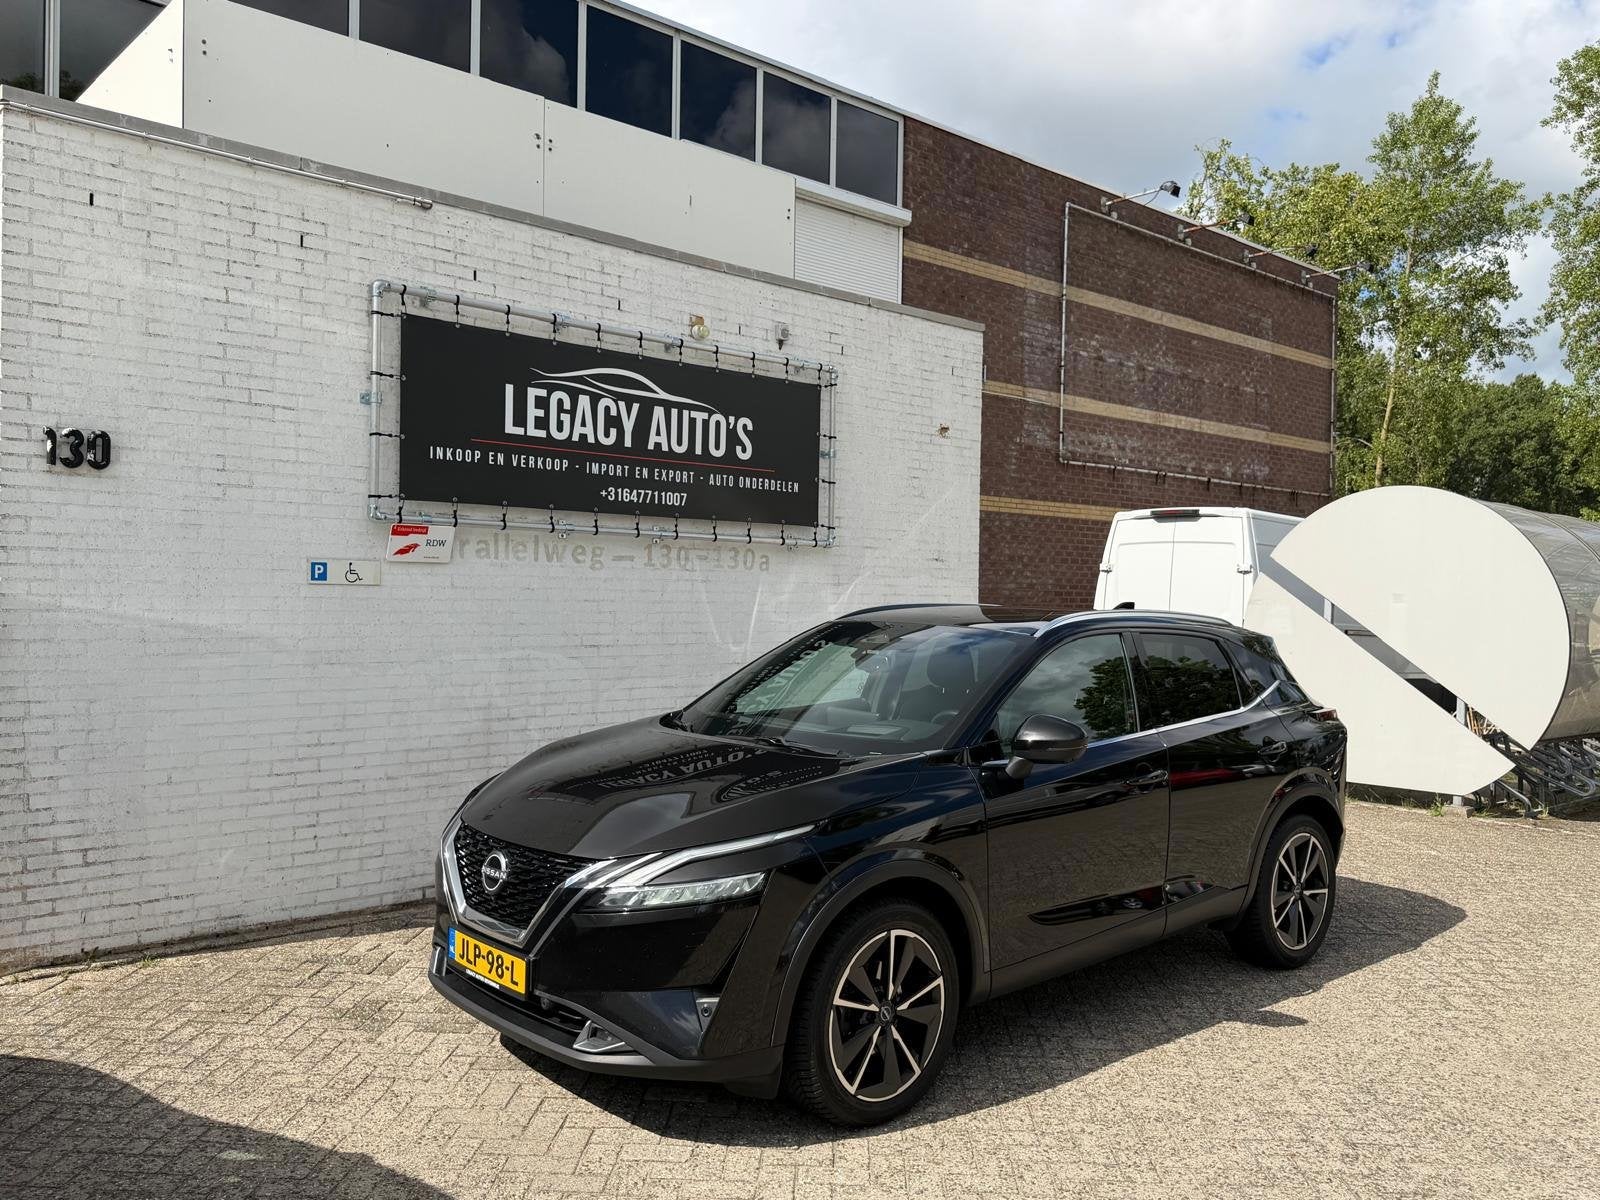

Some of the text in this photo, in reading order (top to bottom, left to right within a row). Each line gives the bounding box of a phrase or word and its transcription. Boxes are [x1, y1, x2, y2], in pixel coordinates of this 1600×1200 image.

[504, 383, 754, 461] LEGACY AUTO'S
[42, 425, 111, 470] 130
[429, 445, 481, 463] INKOOP
[488, 452, 504, 465] EN
[511, 454, 569, 471] VERKOOP
[586, 461, 630, 478] IMPORT
[635, 467, 648, 479] EN
[654, 469, 695, 484] EXPORT
[709, 474, 734, 487] AUTO
[739, 476, 800, 493] ONDERDELEN
[600, 487, 688, 506] +31647711007
[425, 539, 447, 547] RDW
[455, 532, 606, 571] rallelweg
[314, 564, 324, 579] P
[459, 937, 519, 987] JLP-98-L
